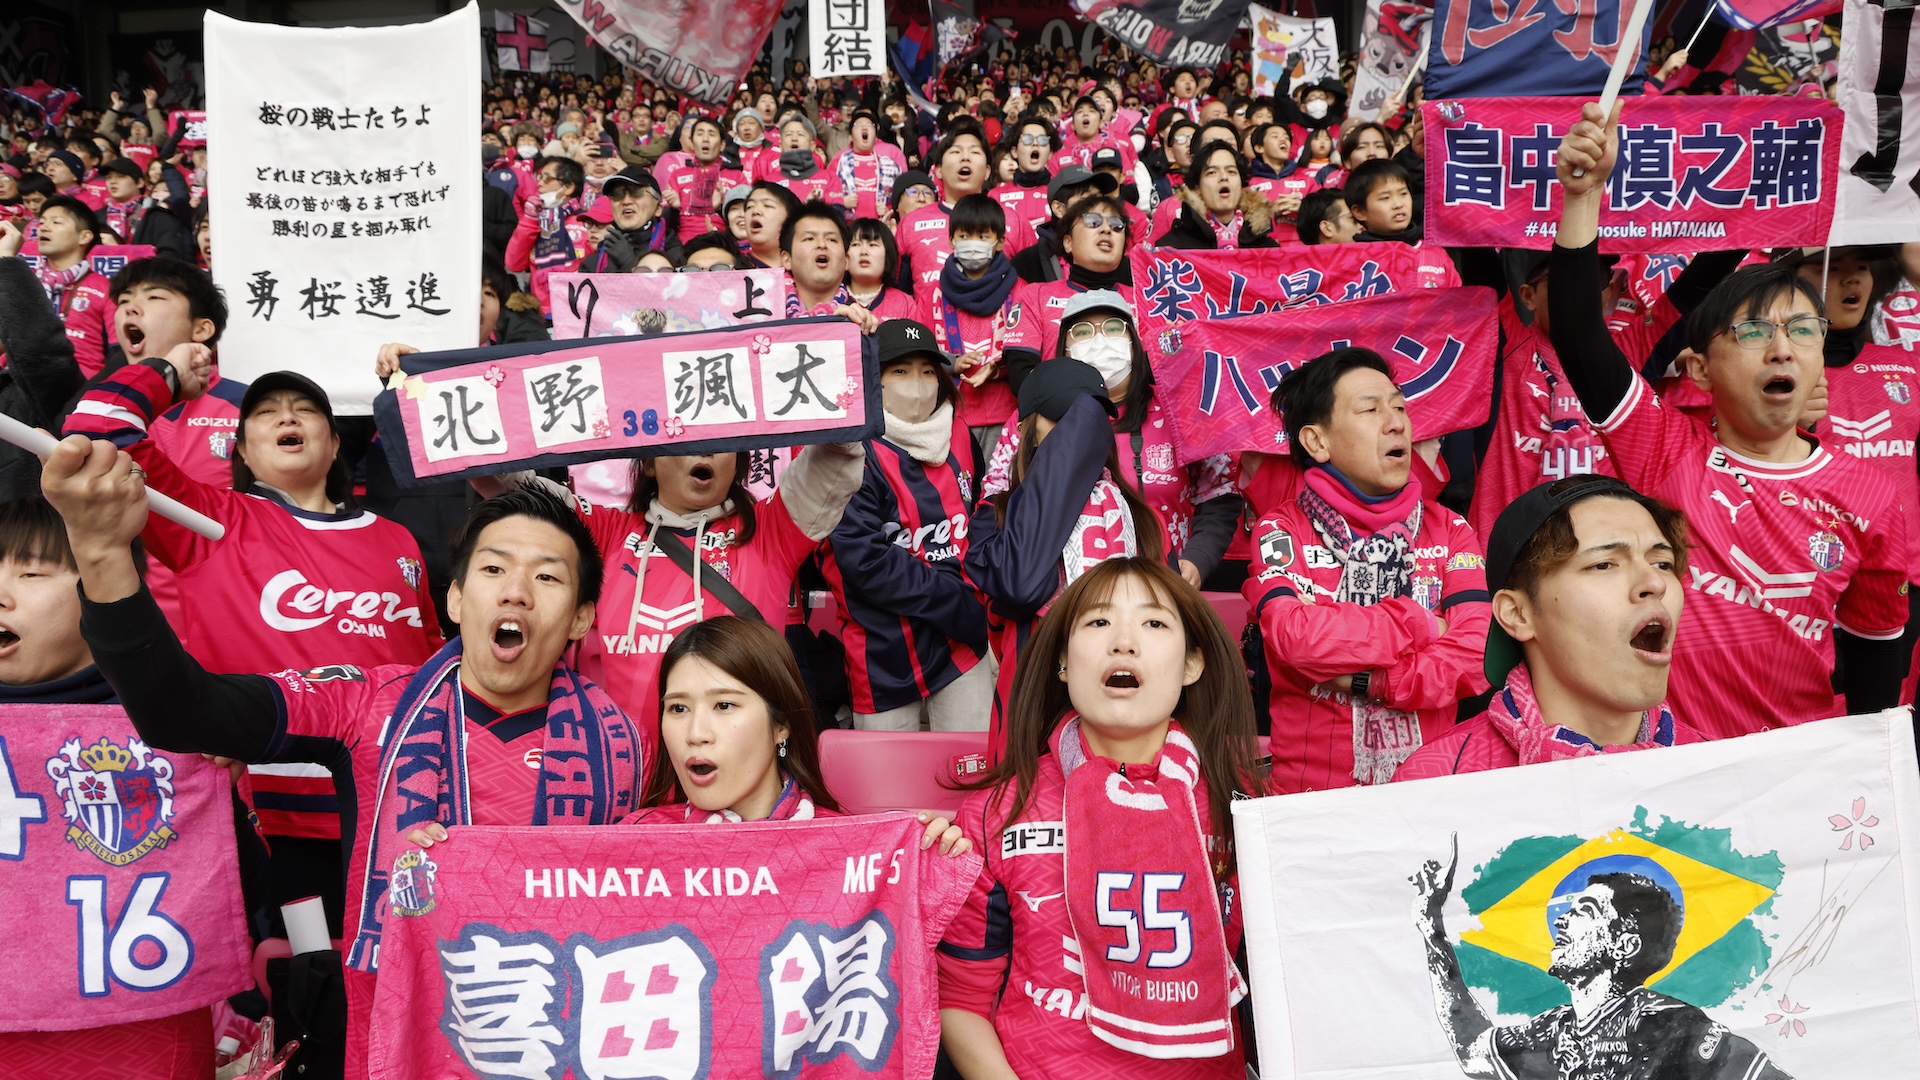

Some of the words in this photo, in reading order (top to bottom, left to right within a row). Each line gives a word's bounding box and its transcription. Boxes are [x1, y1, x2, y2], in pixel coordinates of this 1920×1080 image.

[258, 101, 431, 130] 桜の戦士たちよ
[256, 161, 437, 186] どれほど強大な相手でも
[246, 185, 450, 213] 最後の笛が鳴るまで恐れず
[272, 216, 432, 239] 勝利の星を掴み取れ
[1525, 222, 1557, 238] #44
[1652, 221, 1726, 238] HATANAKA
[246, 270, 452, 322] 勇桜邁進
[433, 344, 840, 451] 北野颯太
[623, 408, 659, 437] 38
[1803, 497, 1870, 533] NIKKON
[924, 545, 961, 563] OSAKA
[83, 833, 118, 861] CEREZO
[119, 836, 158, 861] OSAKA
[525, 867, 672, 898] HINATA
[684, 866, 779, 897] KIDA
[842, 852, 882, 894] MF
[887, 848, 905, 885] 5
[67, 873, 193, 996] 16
[1096, 871, 1193, 968] 55
[440, 917, 891, 1080] 喜田陽
[1110, 970, 1142, 1000] VITOR
[1146, 980, 1199, 1003] BUENO
